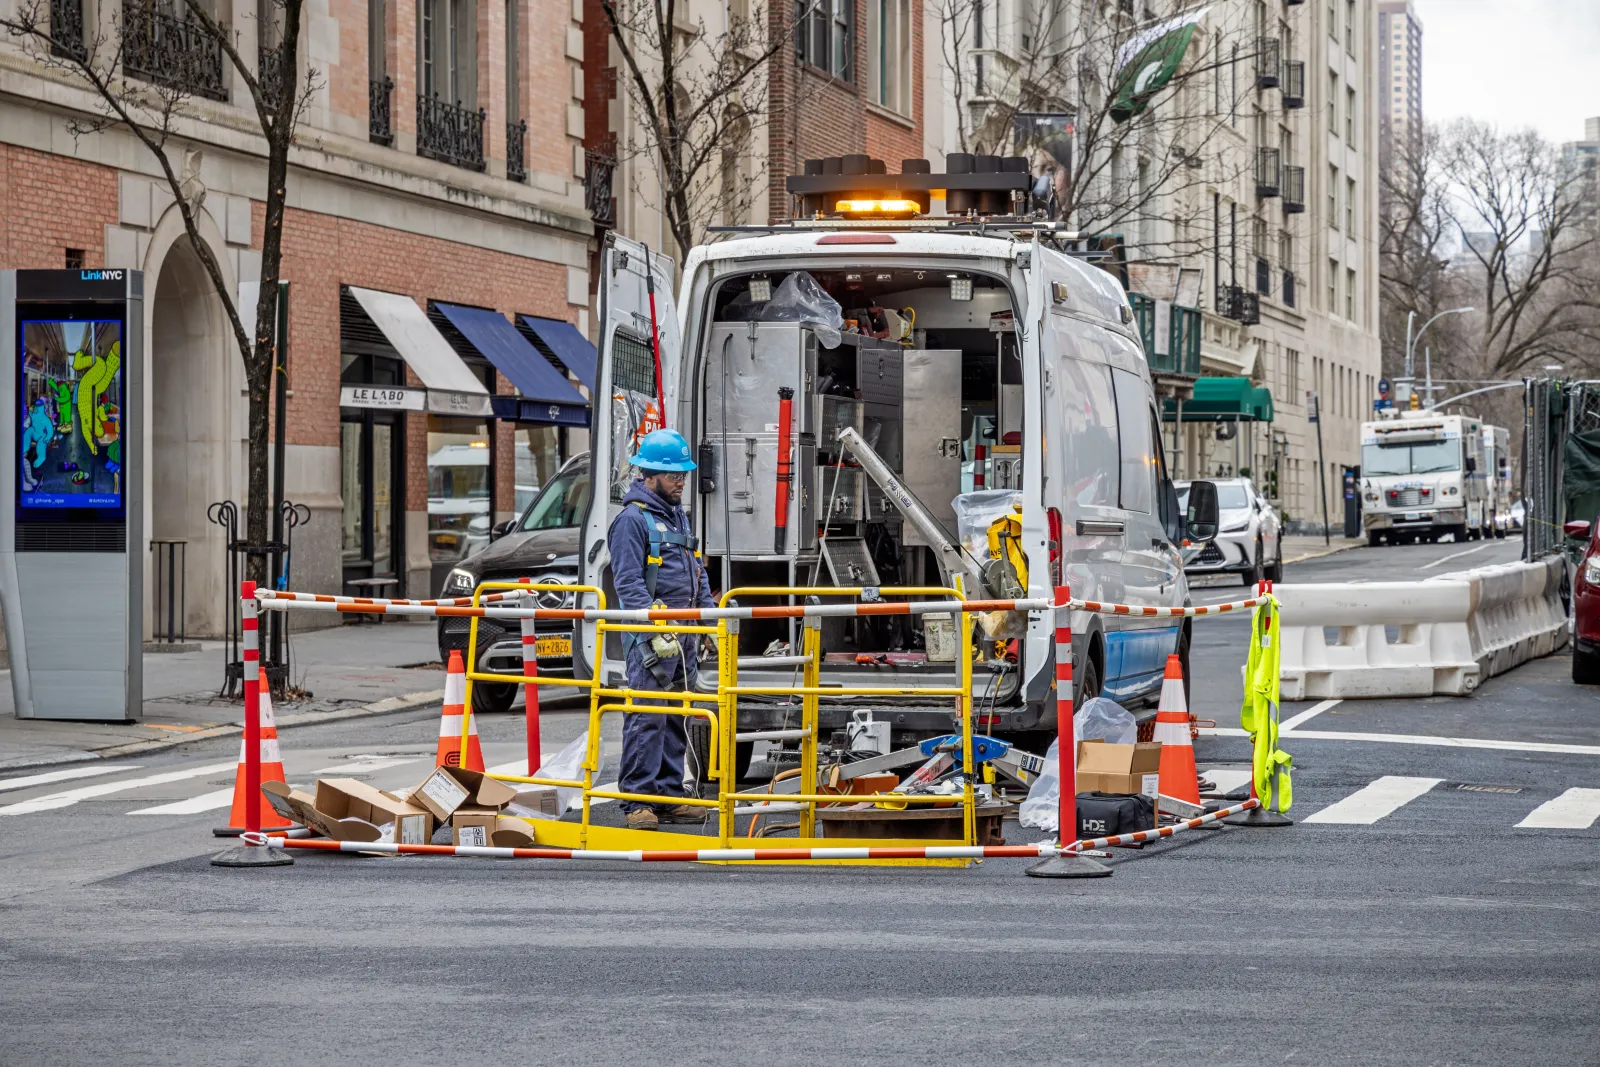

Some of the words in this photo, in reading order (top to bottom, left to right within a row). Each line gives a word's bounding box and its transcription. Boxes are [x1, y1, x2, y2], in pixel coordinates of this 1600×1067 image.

[81, 270, 122, 280] LinkNYC
[353, 389, 368, 399] LE
[372, 390, 404, 401] LABO
[1082, 818, 1106, 831] HDE
